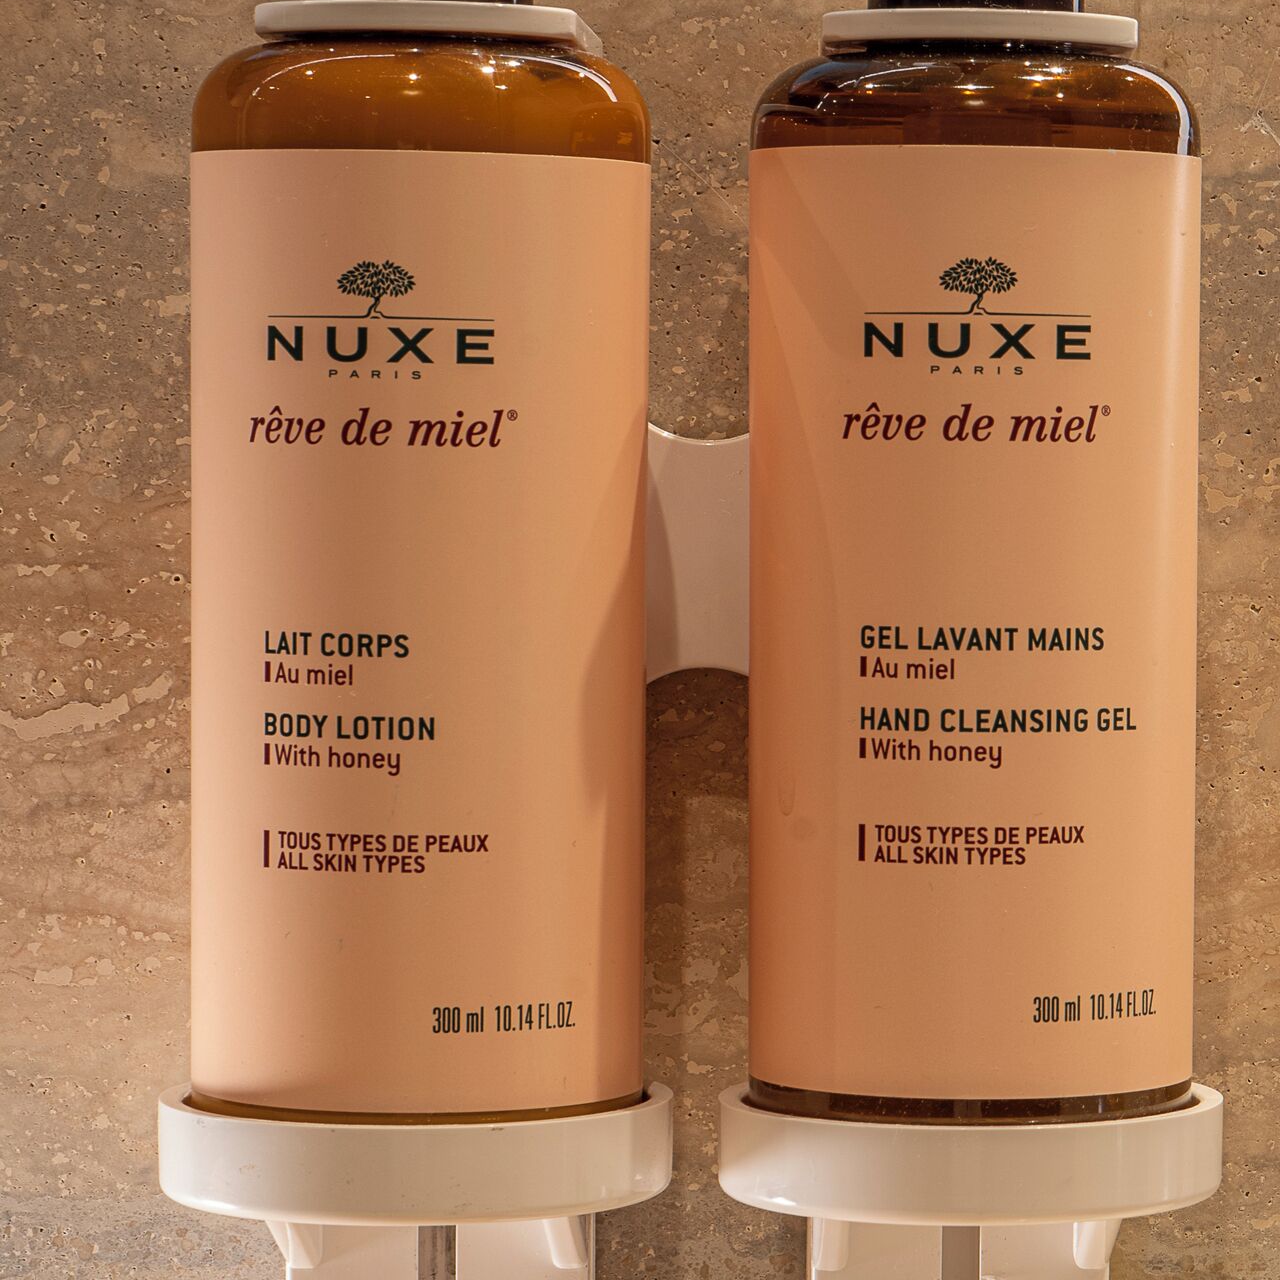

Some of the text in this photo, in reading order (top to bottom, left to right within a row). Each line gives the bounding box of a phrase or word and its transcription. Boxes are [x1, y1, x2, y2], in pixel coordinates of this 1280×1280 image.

[267, 325, 495, 365] NUXE
[863, 321, 1092, 361] NUXE
[328, 369, 422, 380] PARIS
[930, 365, 1024, 376] PARIS
[249, 405, 326, 446] rêve
[341, 407, 393, 447] de
[842, 401, 927, 441] rêve
[942, 403, 995, 442] de
[265, 630, 410, 659] LAIT CORPS
[860, 624, 1105, 652] GEL LAVANT MAINS
[274, 661, 354, 686] Au miel
[871, 656, 955, 680] Au miel
[264, 712, 435, 741] BODY LOTION
[860, 706, 1137, 733] HAND CLEANSING GEL
[274, 743, 401, 777] With honey
[871, 737, 1002, 770] With honey
[278, 831, 489, 853] TOUS TYPES DE PEAUX
[875, 825, 1085, 845] TOUS TYPES DE PEAUX
[277, 851, 426, 874] ALL SKIN TYPES
[874, 844, 1026, 866] ALL SKIN TYPES
[432, 1000, 576, 1034] 300 ml 10.14 FL.OZ.
[1033, 988, 1157, 1024] 300 ml 10.14 FL.OZ.
